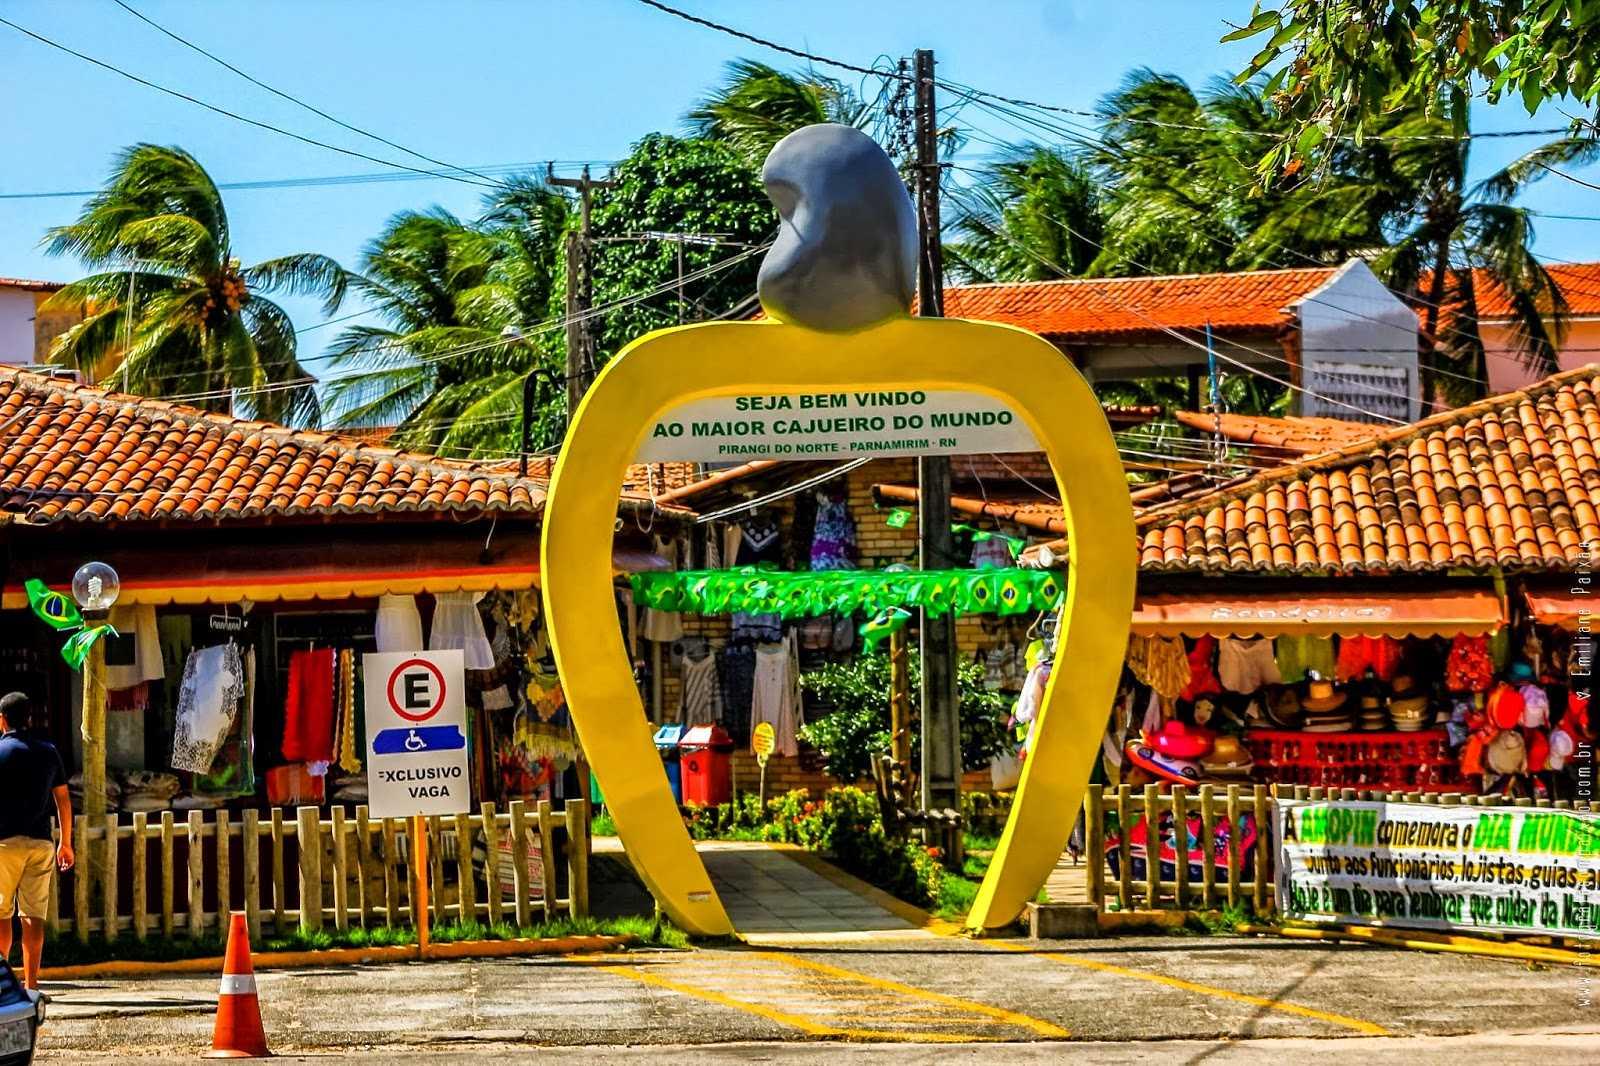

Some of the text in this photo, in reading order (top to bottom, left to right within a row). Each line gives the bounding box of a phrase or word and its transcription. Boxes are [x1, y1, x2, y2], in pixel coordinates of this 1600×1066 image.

[735, 391, 926, 411] SEJA BEM VINDO
[653, 410, 1013, 437] AO MAIOR CAJUEIRO DO MUNDO
[718, 444, 770, 455] PIRANGI
[774, 444, 792, 454] DO
[796, 442, 839, 453] NORTE
[850, 439, 929, 452] PARNAMIRIM
[939, 438, 957, 448] RN
[404, 673, 431, 709] E
[408, 786, 450, 798] VAGA
[1284, 808, 1298, 843] A
[1377, 820, 1459, 849] comemora
[1462, 824, 1473, 847] o
[1473, 813, 1511, 850] DIA
[1345, 855, 1368, 876] aos
[1469, 893, 1493, 926] que
[1541, 892, 1558, 927] da
